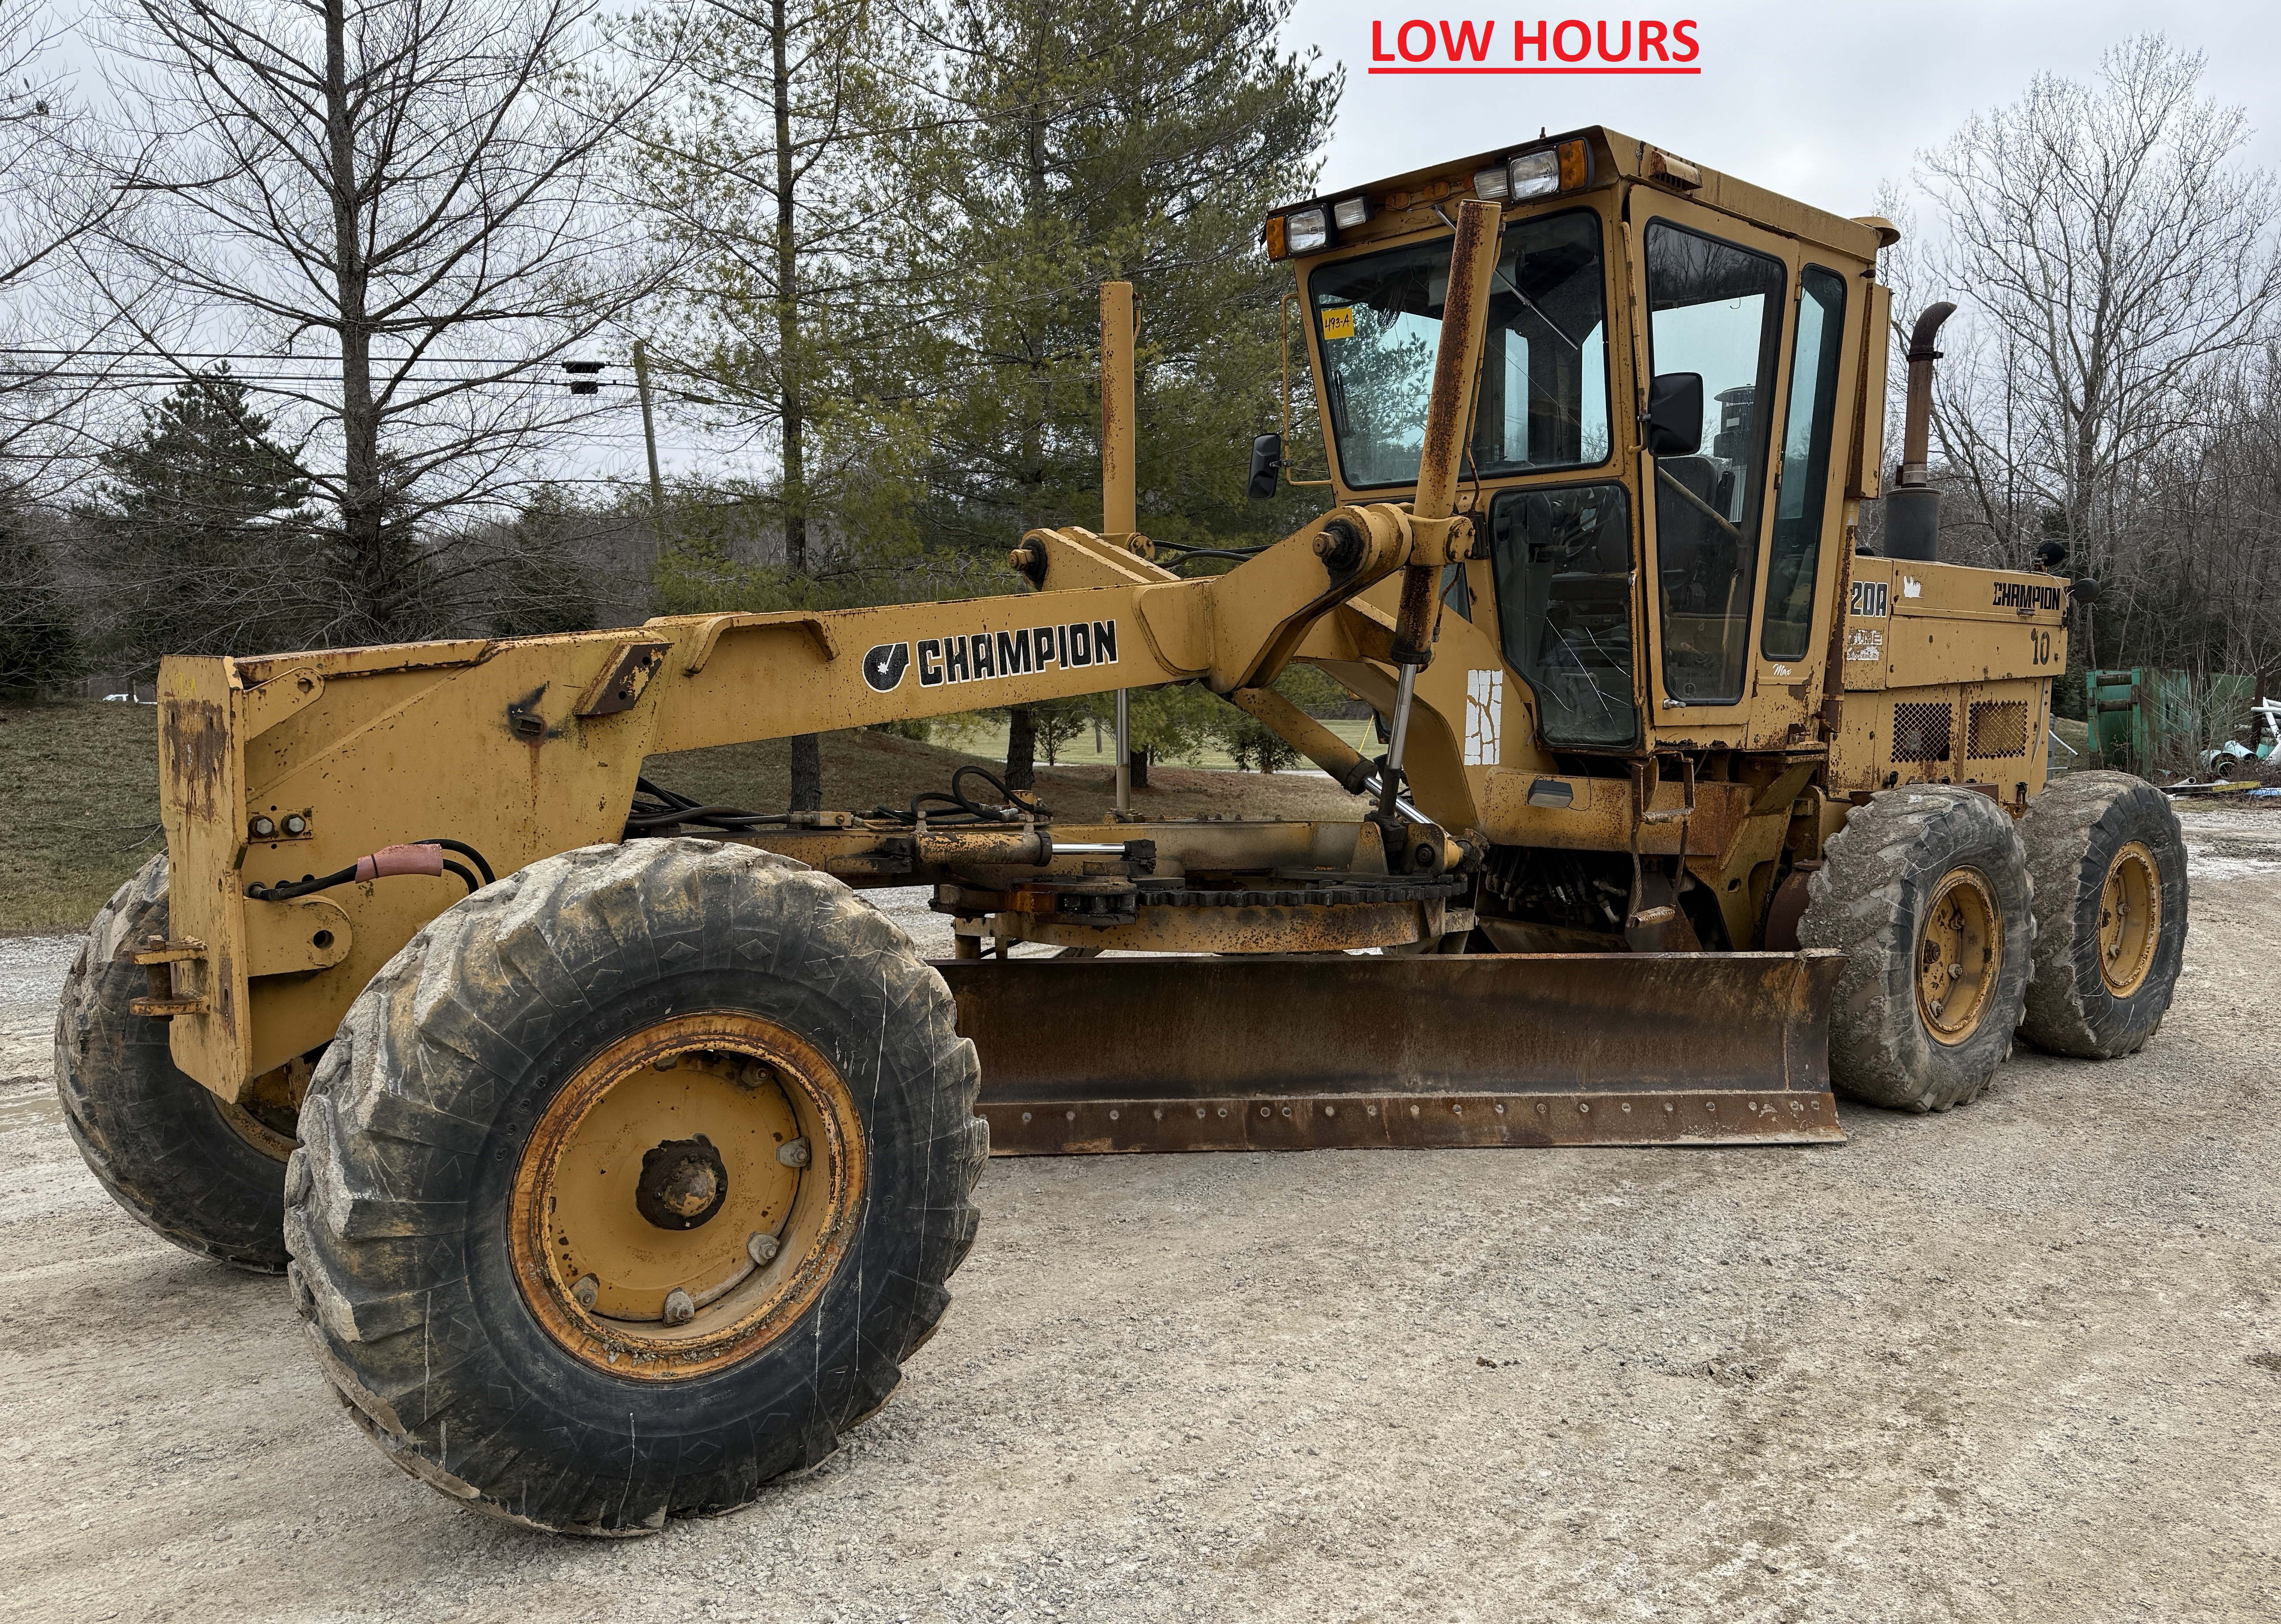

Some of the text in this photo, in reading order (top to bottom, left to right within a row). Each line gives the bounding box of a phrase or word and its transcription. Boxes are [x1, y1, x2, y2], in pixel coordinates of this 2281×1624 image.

[1325, 314, 1350, 332] 493-A
[1993, 582, 2061, 611] CHAMPION
[916, 619, 1119, 688] CHAMPION
[1773, 664, 1792, 677] Max
